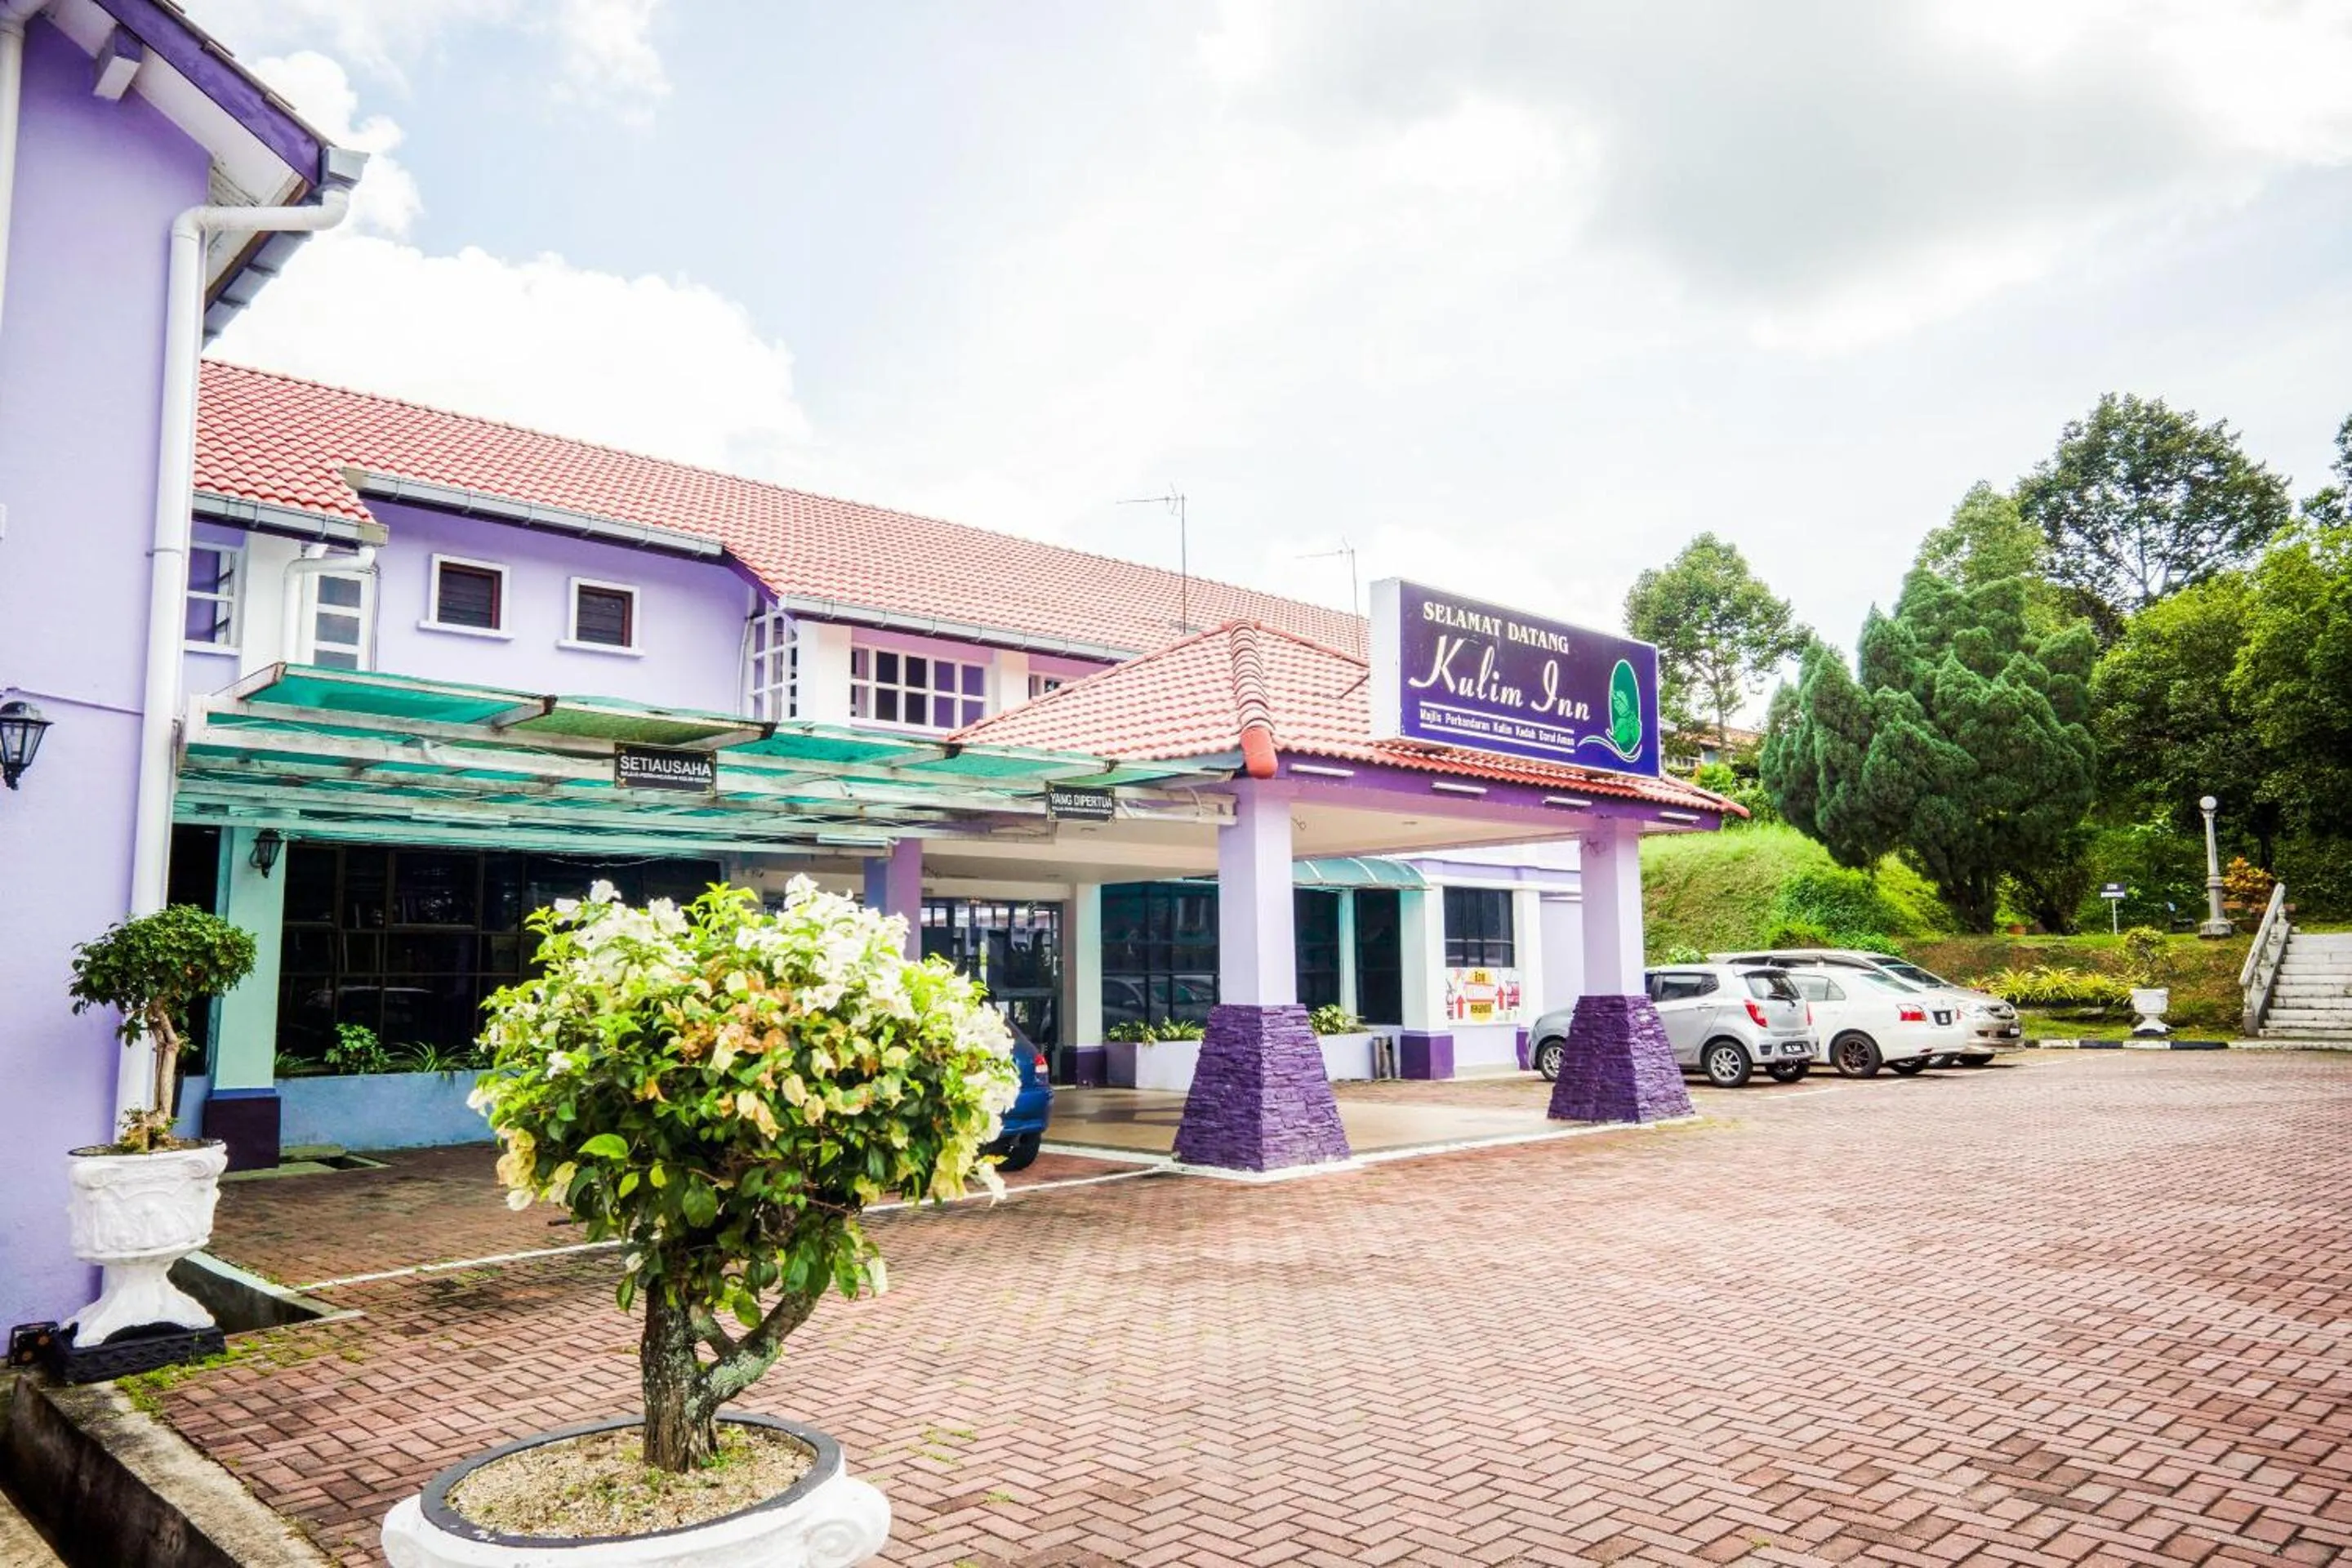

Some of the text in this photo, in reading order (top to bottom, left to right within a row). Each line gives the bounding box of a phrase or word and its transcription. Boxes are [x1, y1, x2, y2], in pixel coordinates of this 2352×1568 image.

[1423, 601, 1569, 654] SELAMAT DATANG
[1408, 635, 1591, 722] Kulim Inn
[620, 755, 711, 777] SETIAUSAHA
[1050, 792, 1112, 808] YANG DIPERTUA
